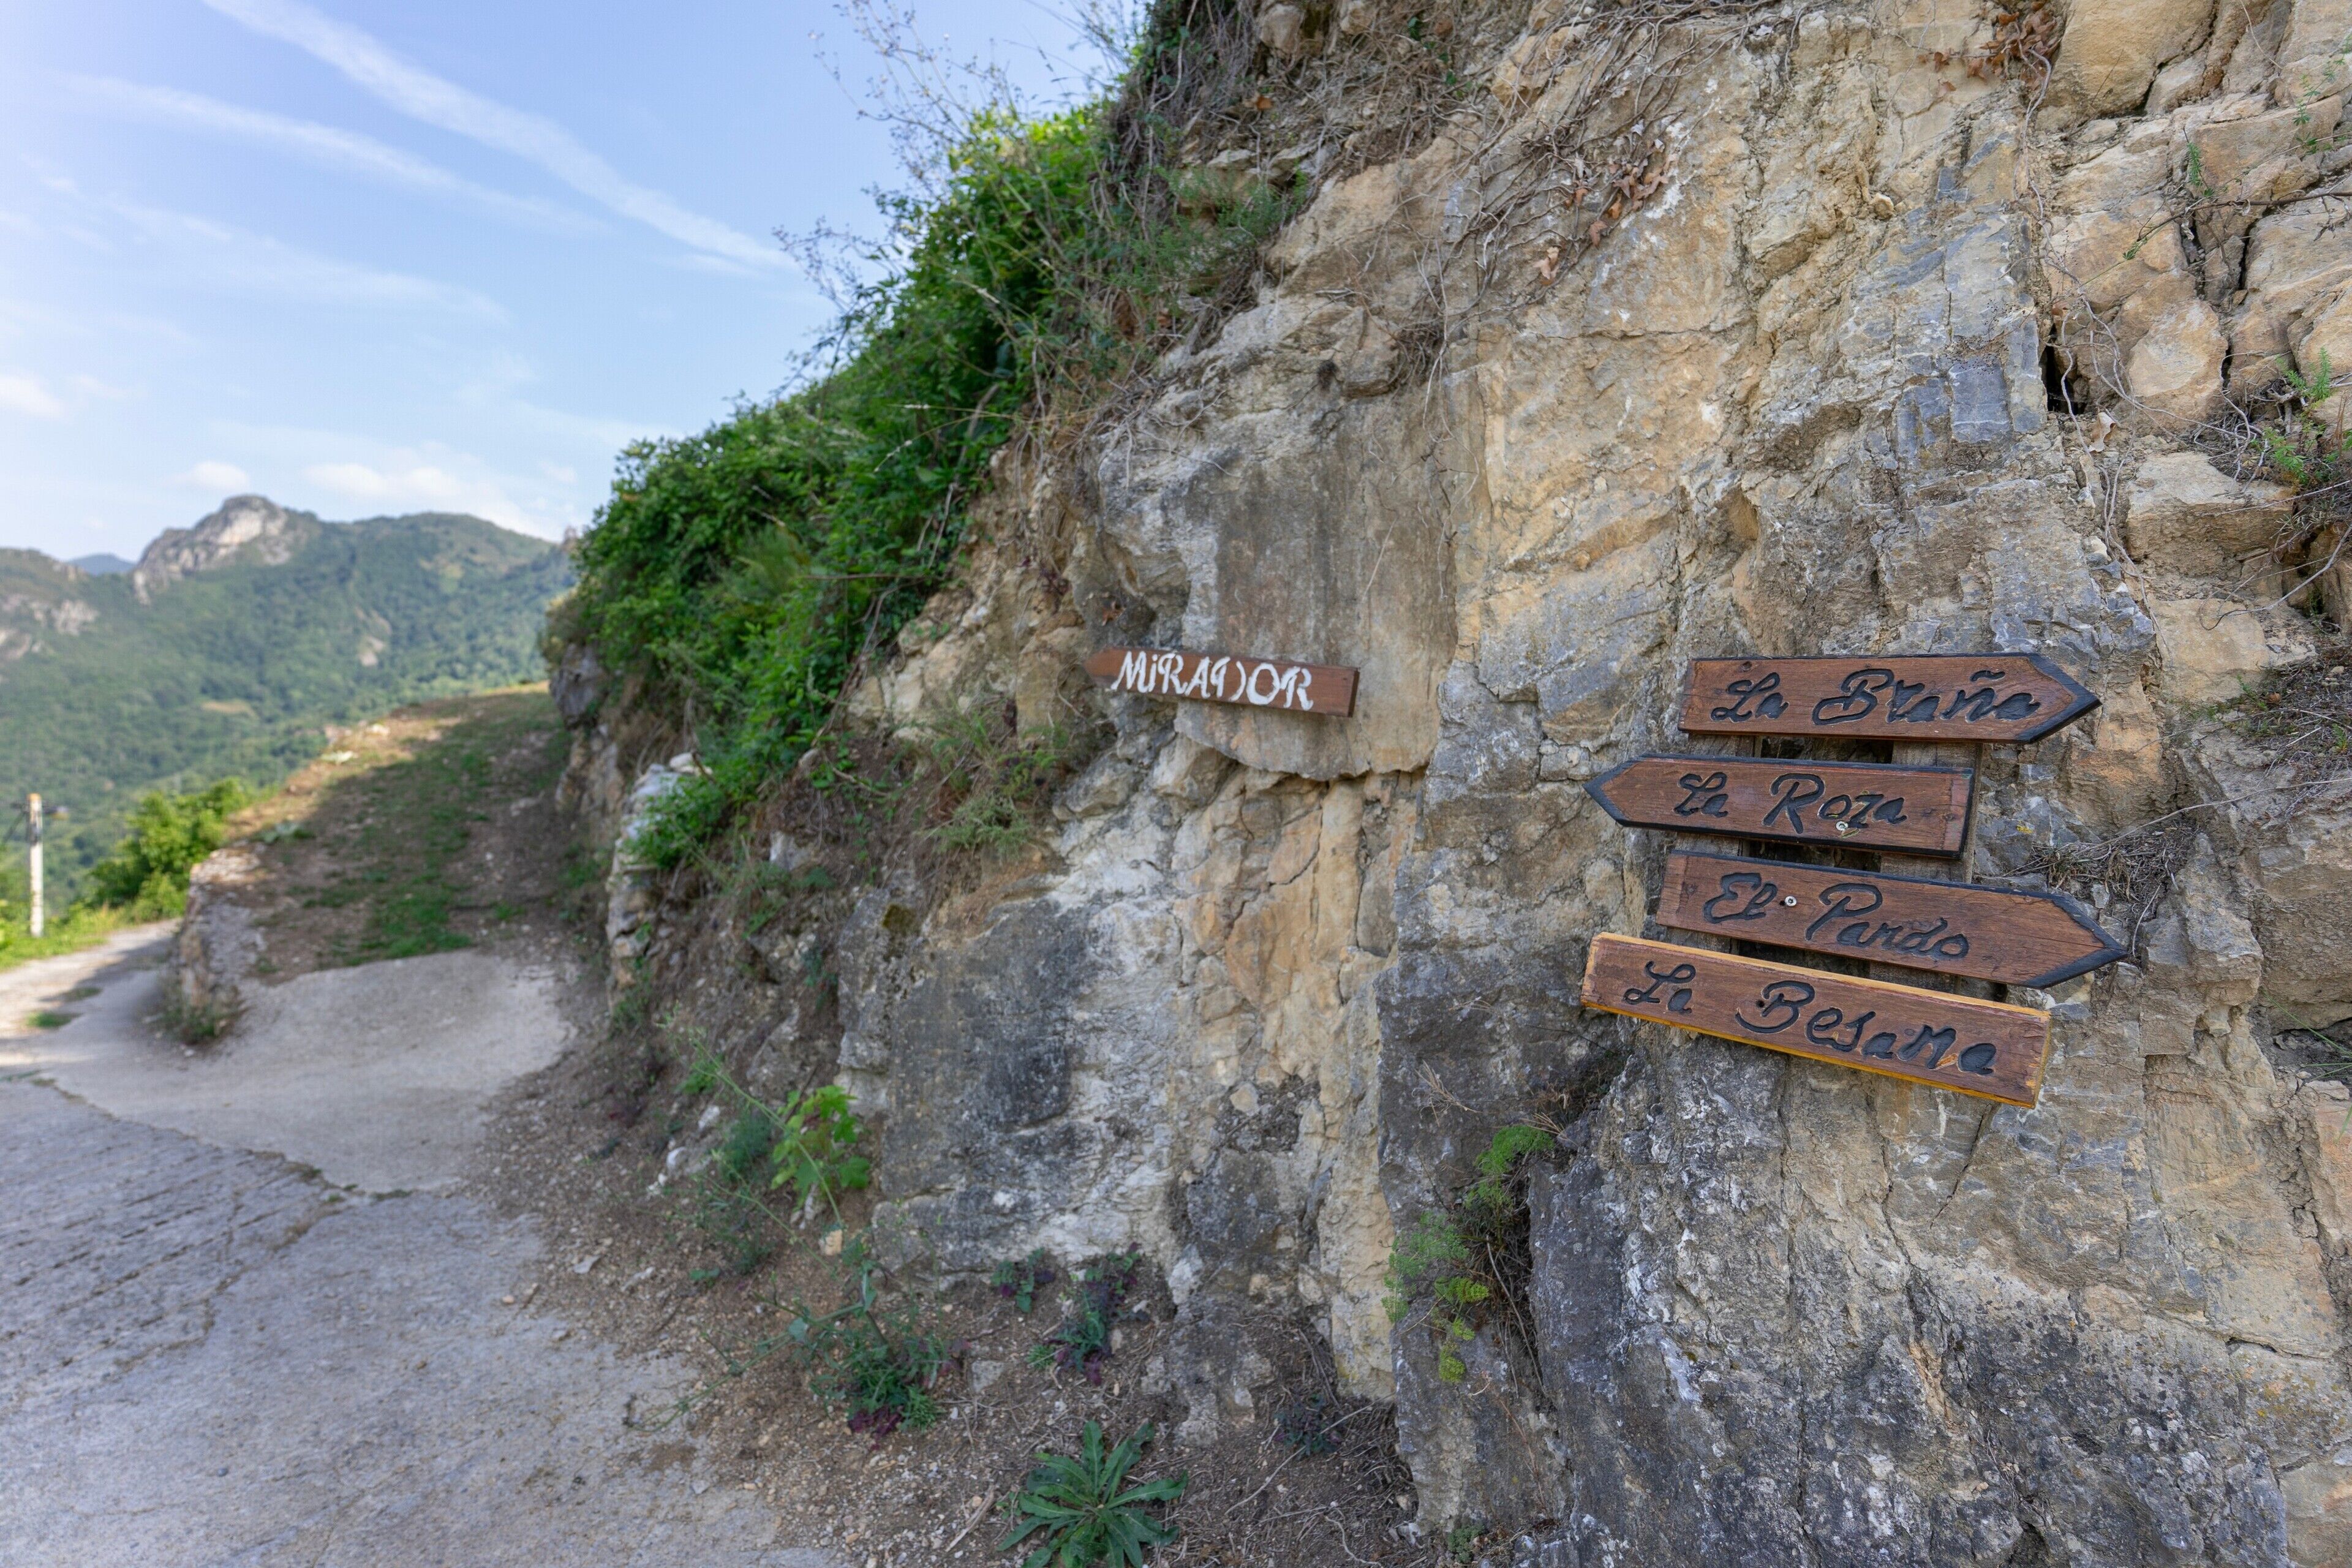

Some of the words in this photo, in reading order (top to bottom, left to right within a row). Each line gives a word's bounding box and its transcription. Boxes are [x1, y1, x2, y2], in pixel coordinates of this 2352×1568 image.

[1710, 672, 1790, 723] La
[1811, 668, 2044, 725] Braña
[1673, 771, 1728, 818] La
[1762, 772, 1909, 838] Roza
[1702, 872, 1779, 924] El
[1804, 882, 1969, 961] Pardo
[1622, 960, 1697, 1015] La
